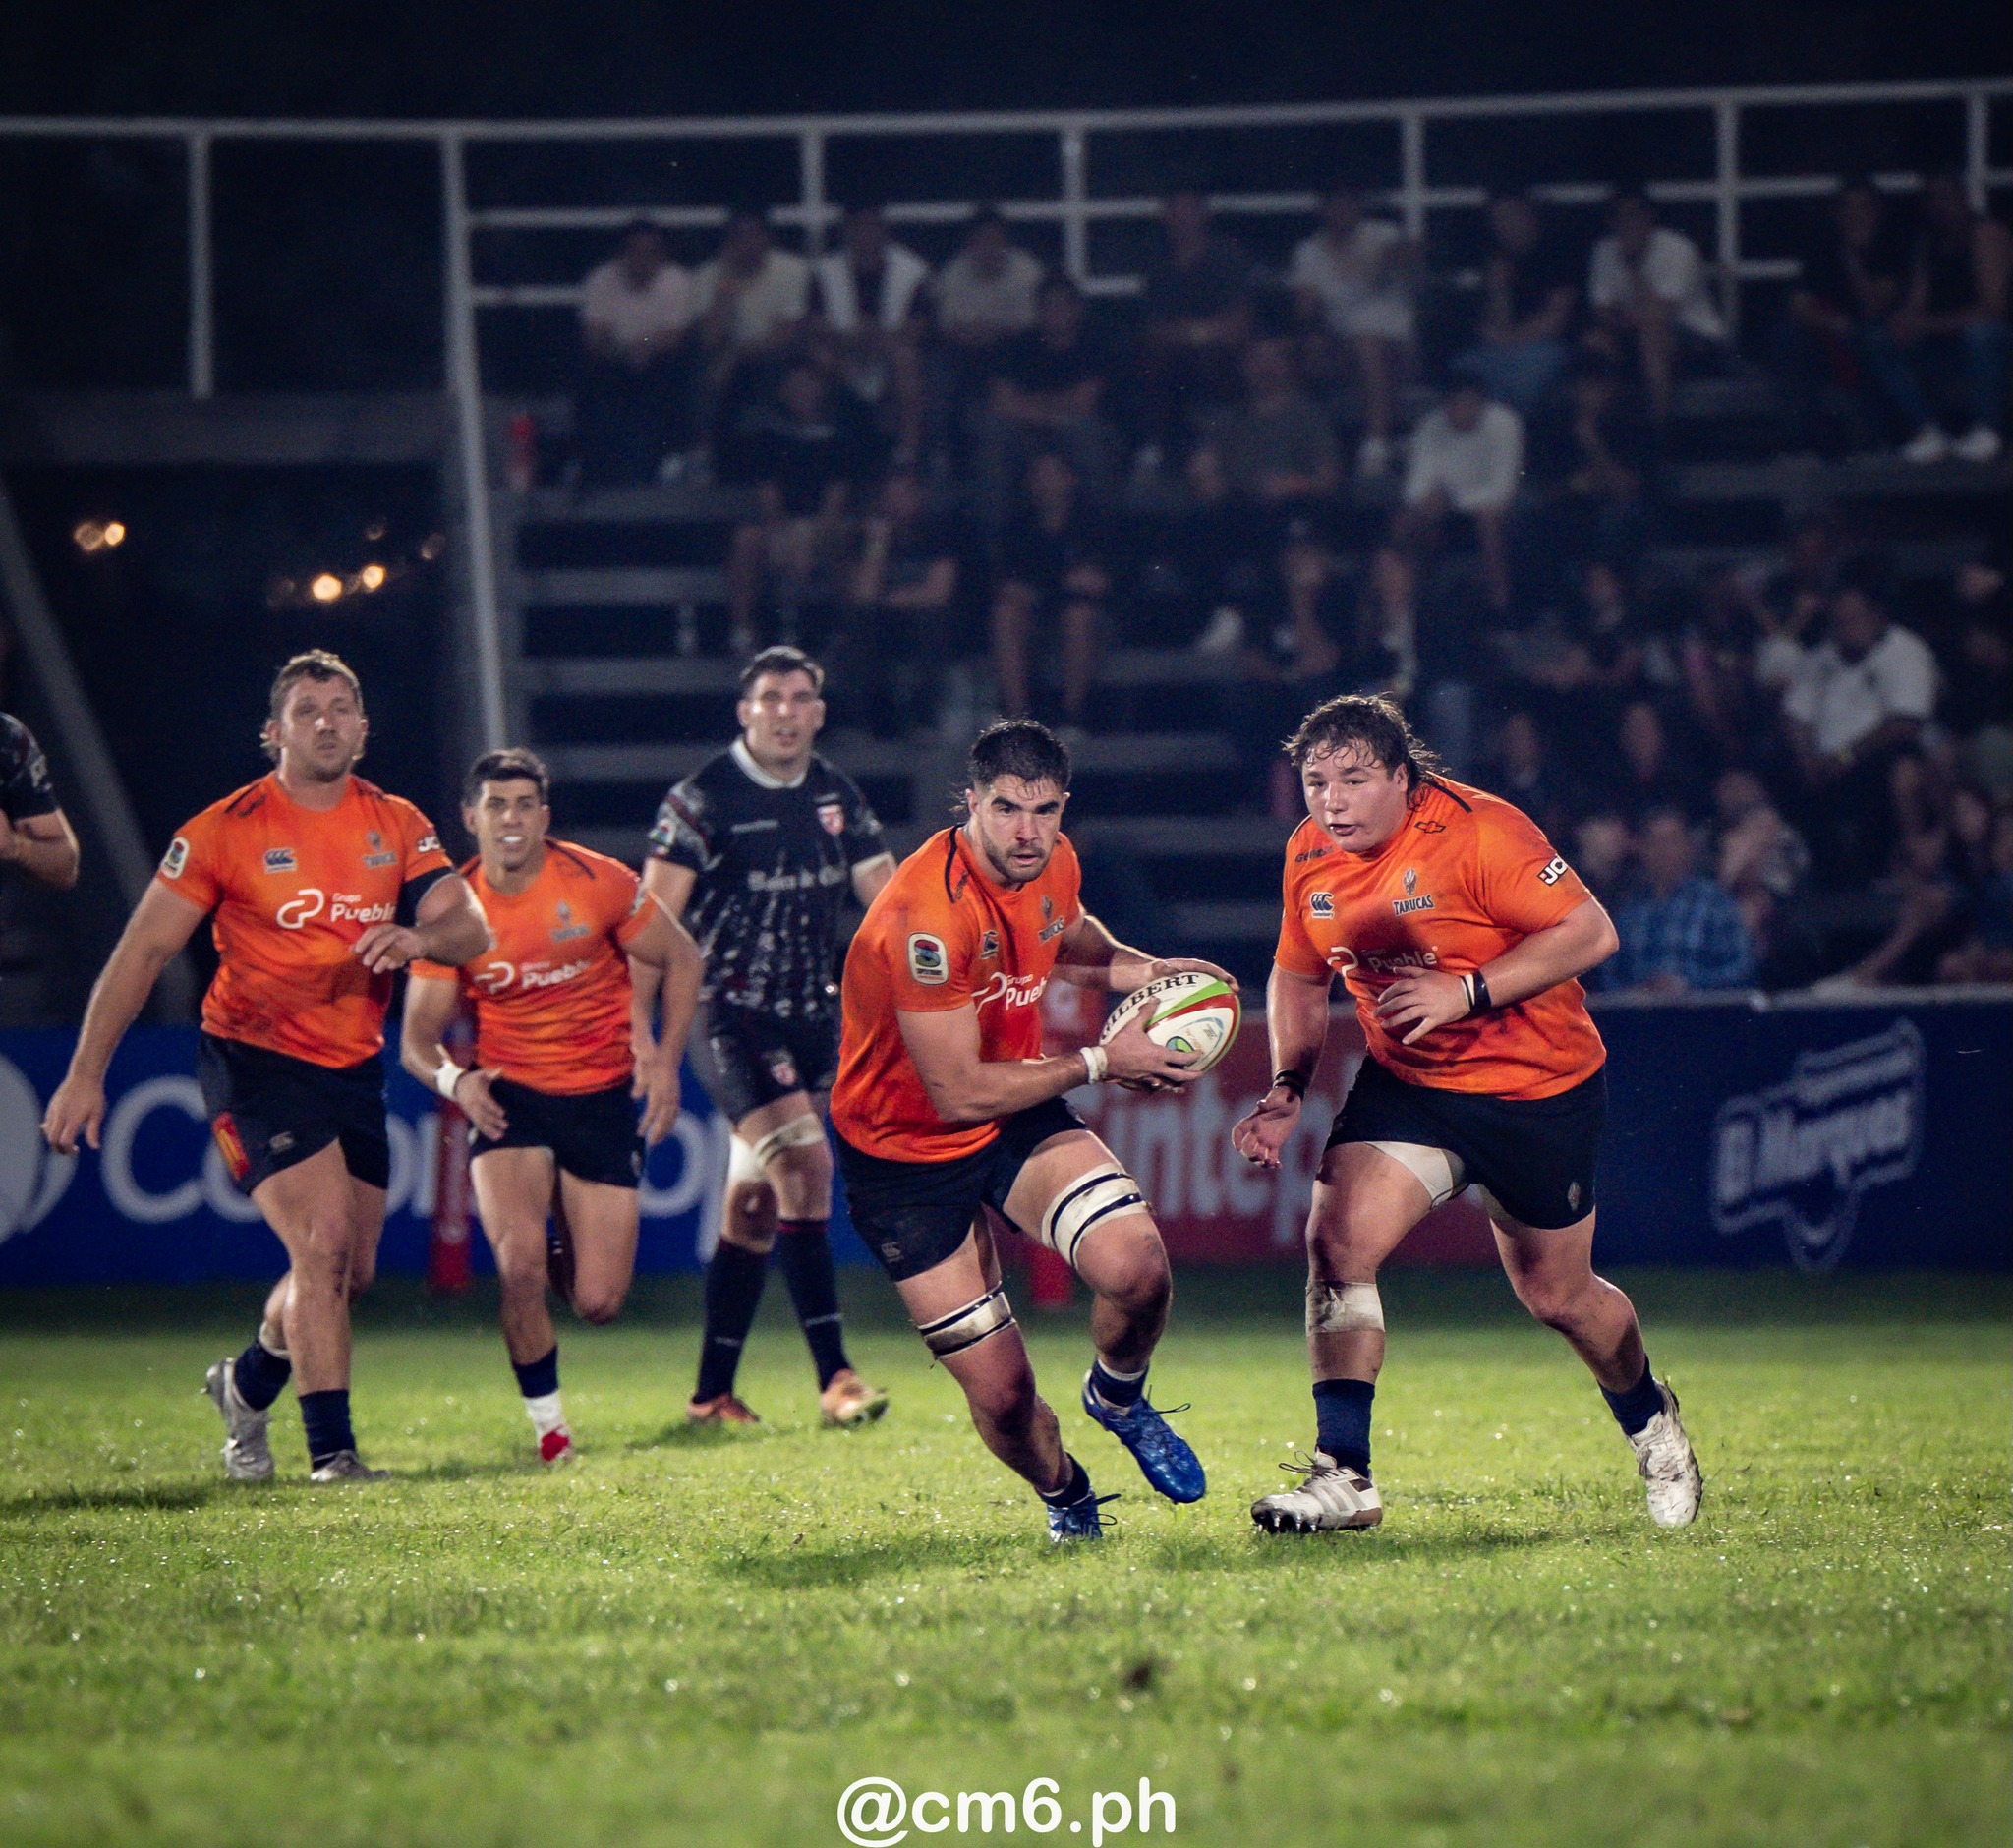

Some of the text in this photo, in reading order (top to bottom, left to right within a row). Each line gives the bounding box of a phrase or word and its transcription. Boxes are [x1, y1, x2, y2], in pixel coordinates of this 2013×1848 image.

[418, 837, 441, 853] JC
[1537, 857, 1568, 884] JC
[1393, 895, 1435, 915] TARUCAS
[1101, 974, 1199, 1040] GILBERT
